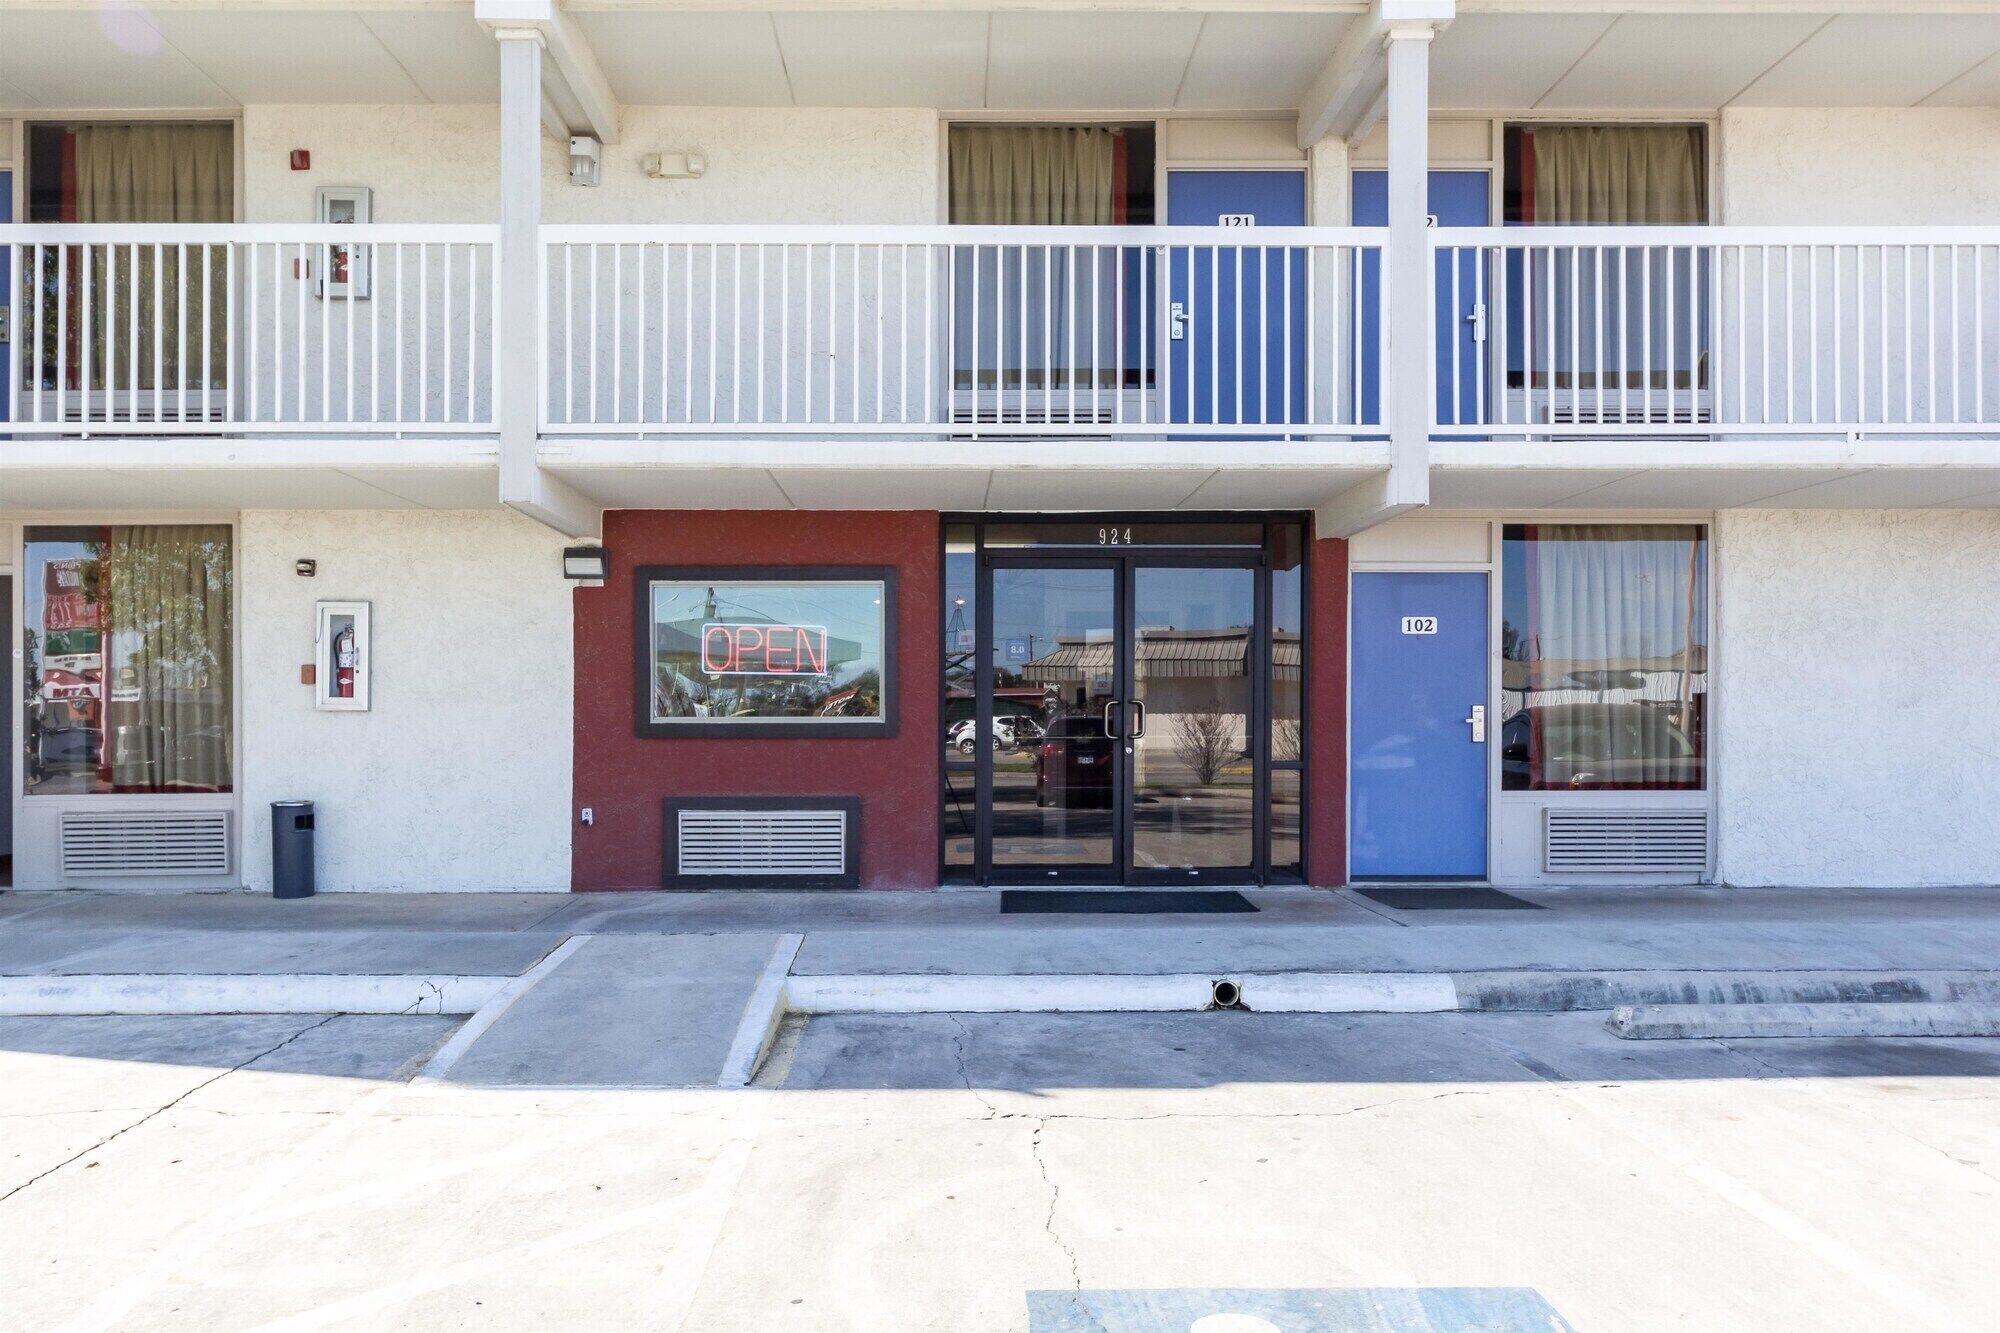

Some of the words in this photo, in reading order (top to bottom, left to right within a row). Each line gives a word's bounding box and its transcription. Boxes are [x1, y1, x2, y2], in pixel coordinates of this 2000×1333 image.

[1225, 216, 1249, 226] 121
[1099, 528, 1131, 545] 924
[1406, 619, 1434, 632] 102
[705, 627, 825, 673] OPEN
[1010, 645, 1025, 654] 8.0
